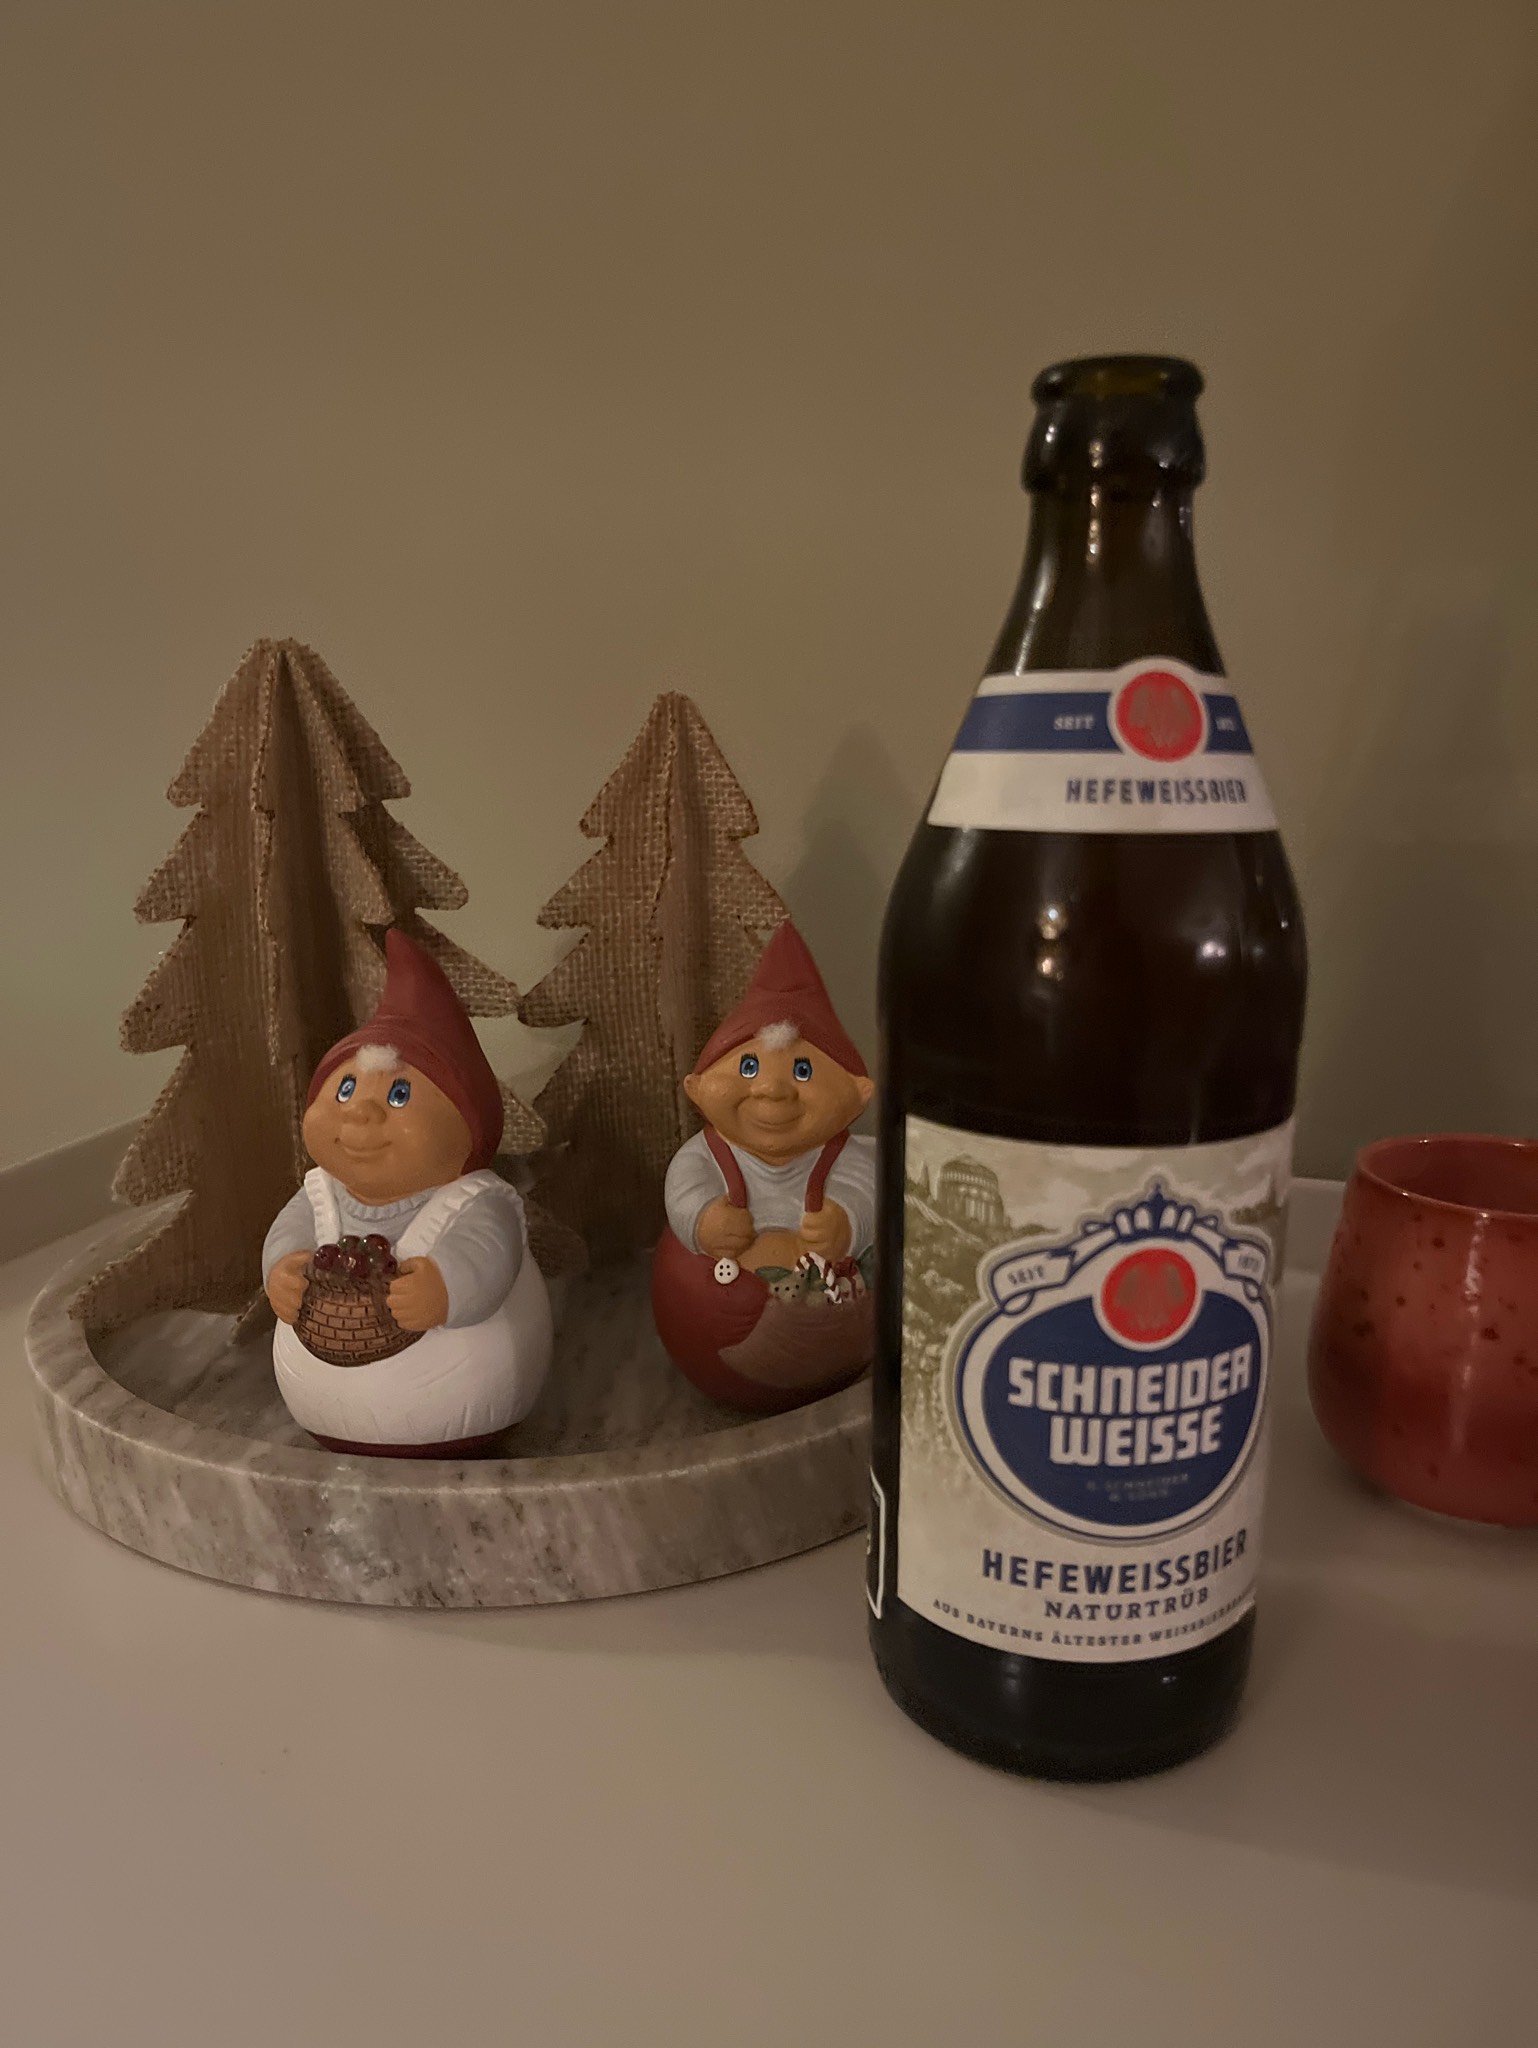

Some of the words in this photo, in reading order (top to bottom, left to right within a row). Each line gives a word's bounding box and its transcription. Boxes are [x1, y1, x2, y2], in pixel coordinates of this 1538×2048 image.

[1054, 715, 1095, 731] SEIT
[1066, 778, 1247, 804] HEFEWEISSBIER
[1007, 1343, 1253, 1416] SCHNEIDER
[1049, 1405, 1224, 1467] WEISSE
[982, 1528, 1249, 1595] HEFEWEISSBIER
[932, 1599, 961, 1619] AUS
[966, 1613, 1044, 1642] BAYERNS
[1051, 1631, 1142, 1647] ÄLTESTER
[1044, 1587, 1210, 1621] NATURTRÜB
